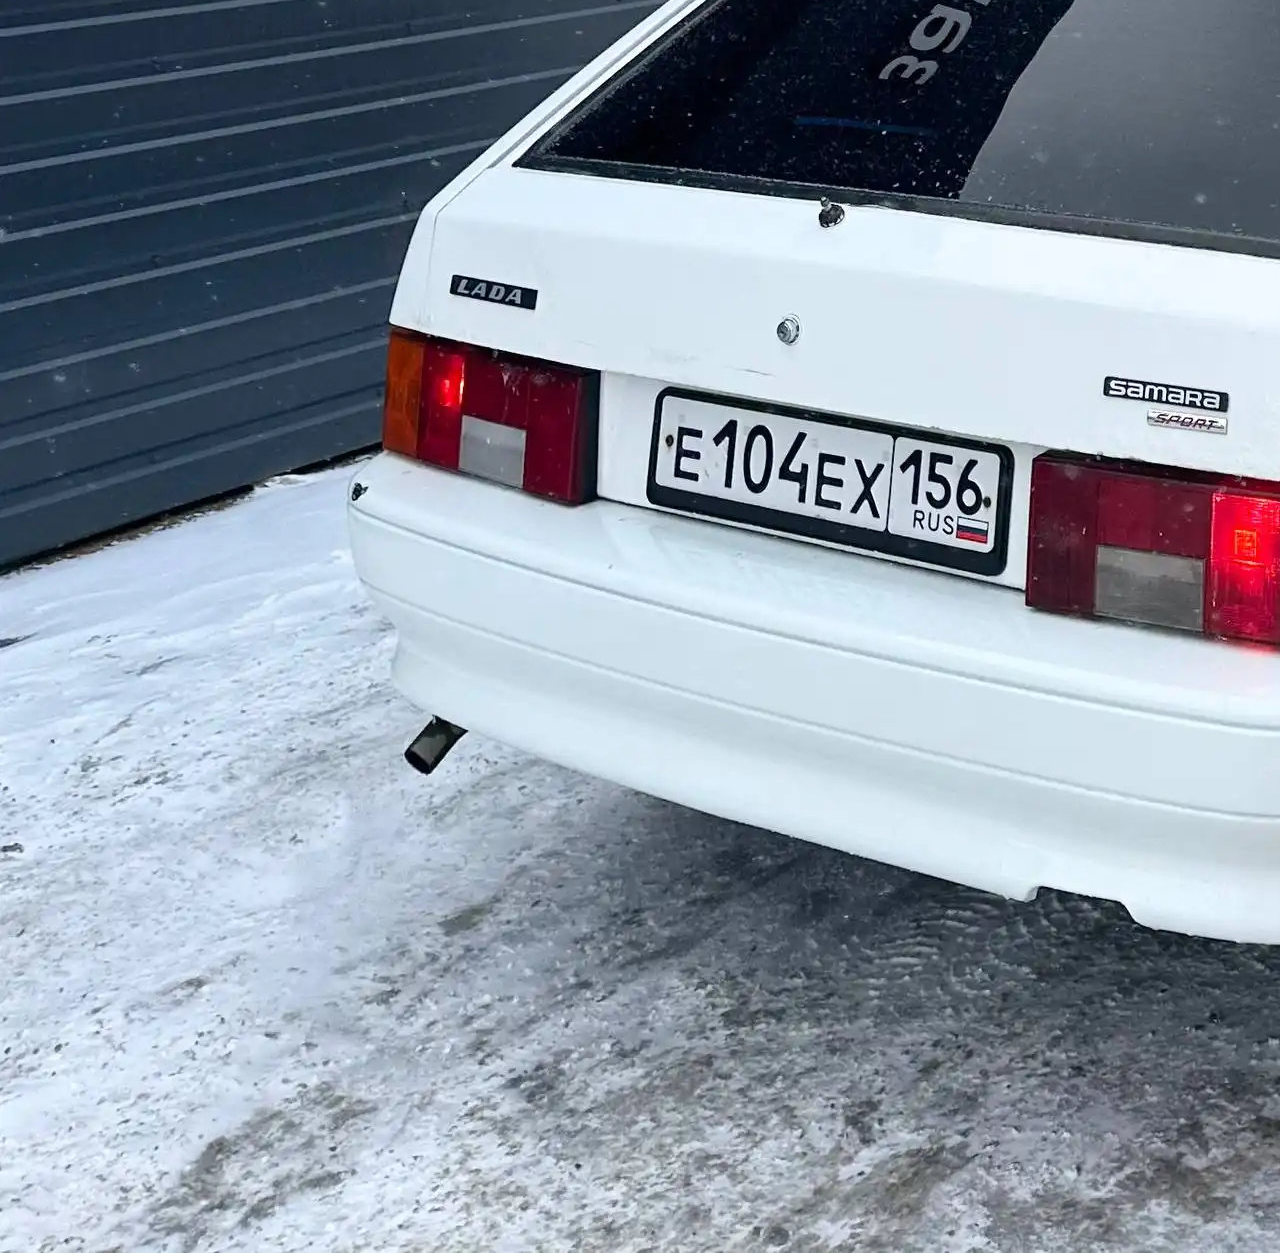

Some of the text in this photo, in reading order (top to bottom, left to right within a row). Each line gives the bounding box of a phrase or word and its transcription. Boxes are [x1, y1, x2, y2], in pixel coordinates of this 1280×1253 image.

[457, 279, 522, 304] LADA
[1154, 413, 1220, 430] SPORT
[900, 449, 983, 515] 156
[913, 509, 955, 535] RUS
